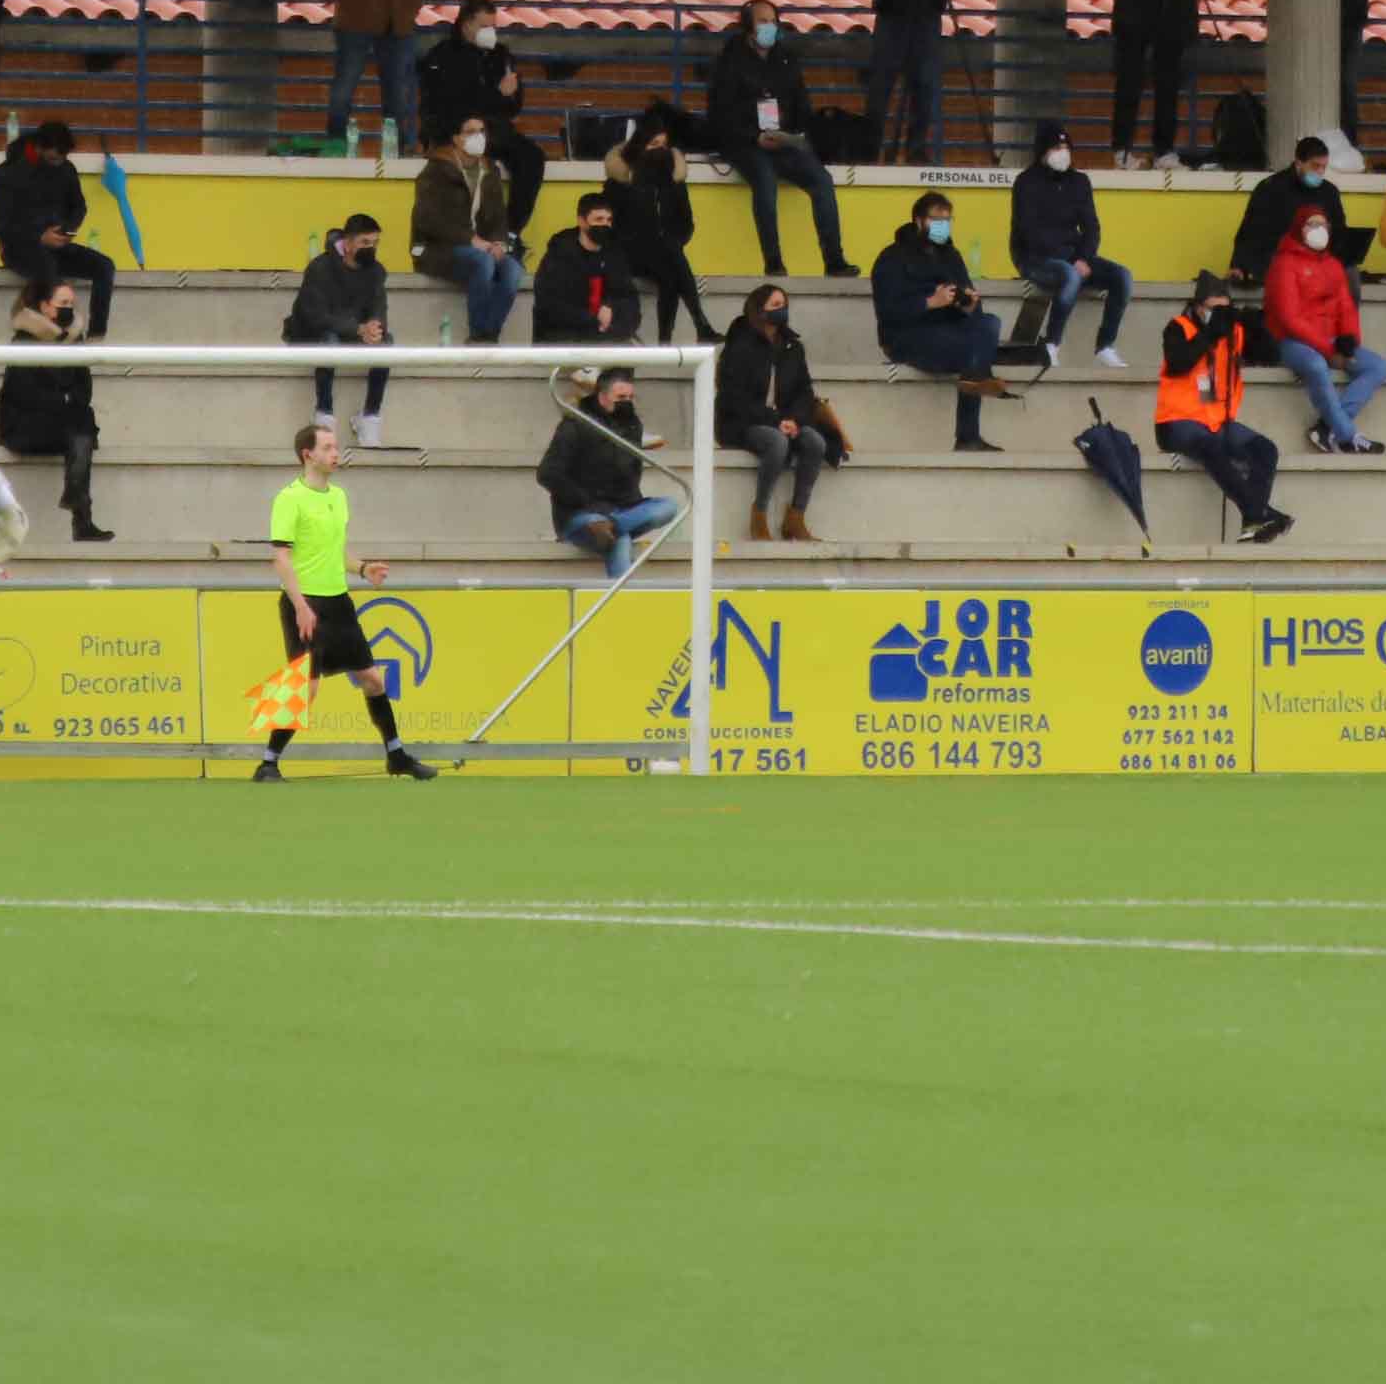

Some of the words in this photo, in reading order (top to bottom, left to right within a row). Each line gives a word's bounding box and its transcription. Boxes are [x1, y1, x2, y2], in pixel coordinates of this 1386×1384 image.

[919, 172, 984, 184] PERSONAL
[988, 174, 1012, 184] DEL
[918, 599, 1033, 638] JOR
[80, 634, 162, 658] Pintura
[1145, 644, 1209, 666] avanti
[917, 638, 1033, 678] CAR
[60, 671, 183, 695] Decorativa
[932, 682, 1031, 703] reformas
[1128, 705, 1160, 720] 923
[1168, 705, 1200, 720] 211
[1207, 705, 1229, 719] 34
[1261, 690, 1367, 715] Materiales
[53, 718, 97, 738] 923
[102, 717, 142, 737] 065
[146, 716, 187, 736] 461
[644, 727, 795, 740] CONSUCCIONES
[855, 713, 943, 733] ELADIO
[951, 713, 1051, 733] NAVEIRA
[1122, 730, 1155, 745] 677
[1162, 730, 1195, 745] 562
[1203, 730, 1235, 745] 142
[756, 747, 807, 772] 561
[861, 741, 915, 769] 686
[930, 741, 980, 769] 144
[991, 741, 1043, 768] 793
[1120, 754, 1153, 770] 686
[1160, 754, 1182, 769] 14
[1188, 754, 1208, 769] 81
[1215, 754, 1237, 769] 06
